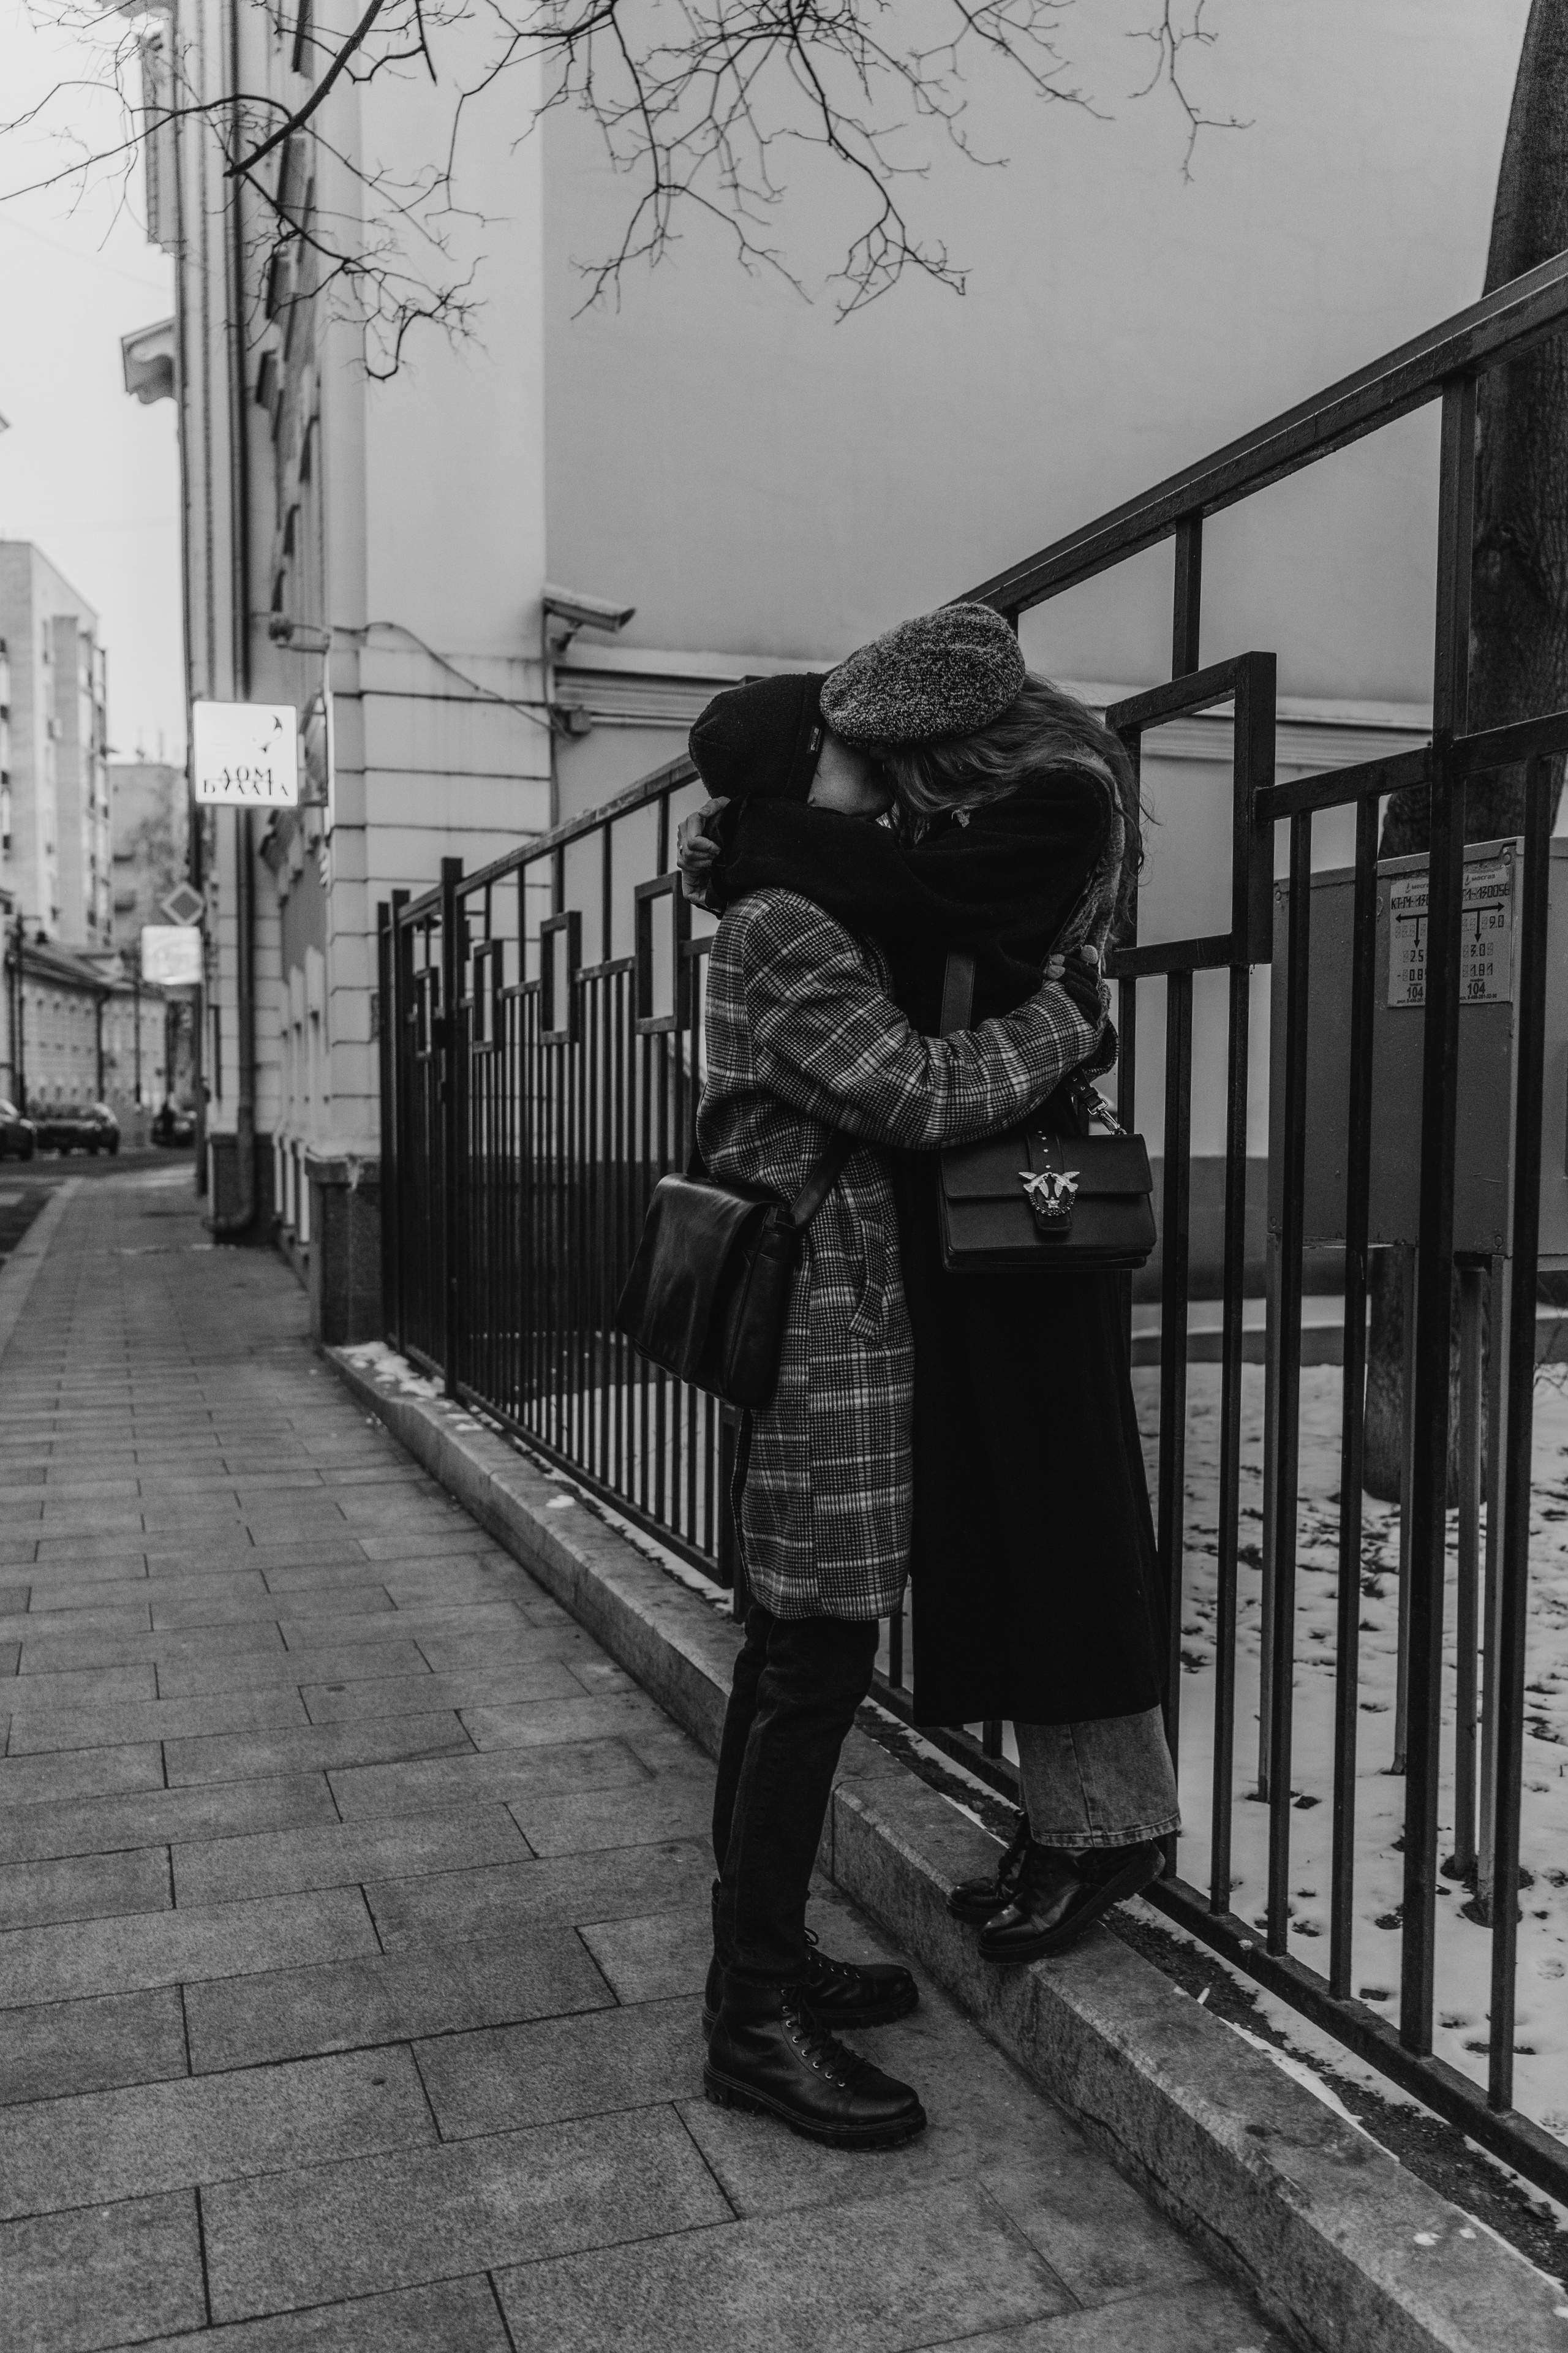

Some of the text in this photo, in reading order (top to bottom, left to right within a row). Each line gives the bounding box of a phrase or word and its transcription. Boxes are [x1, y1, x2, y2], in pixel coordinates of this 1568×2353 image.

[1490, 915, 1504, 929] 9.0
[1410, 949, 1424, 962] 2.5
[1407, 986, 1423, 999] 104
[1468, 981, 1485, 995] 104
